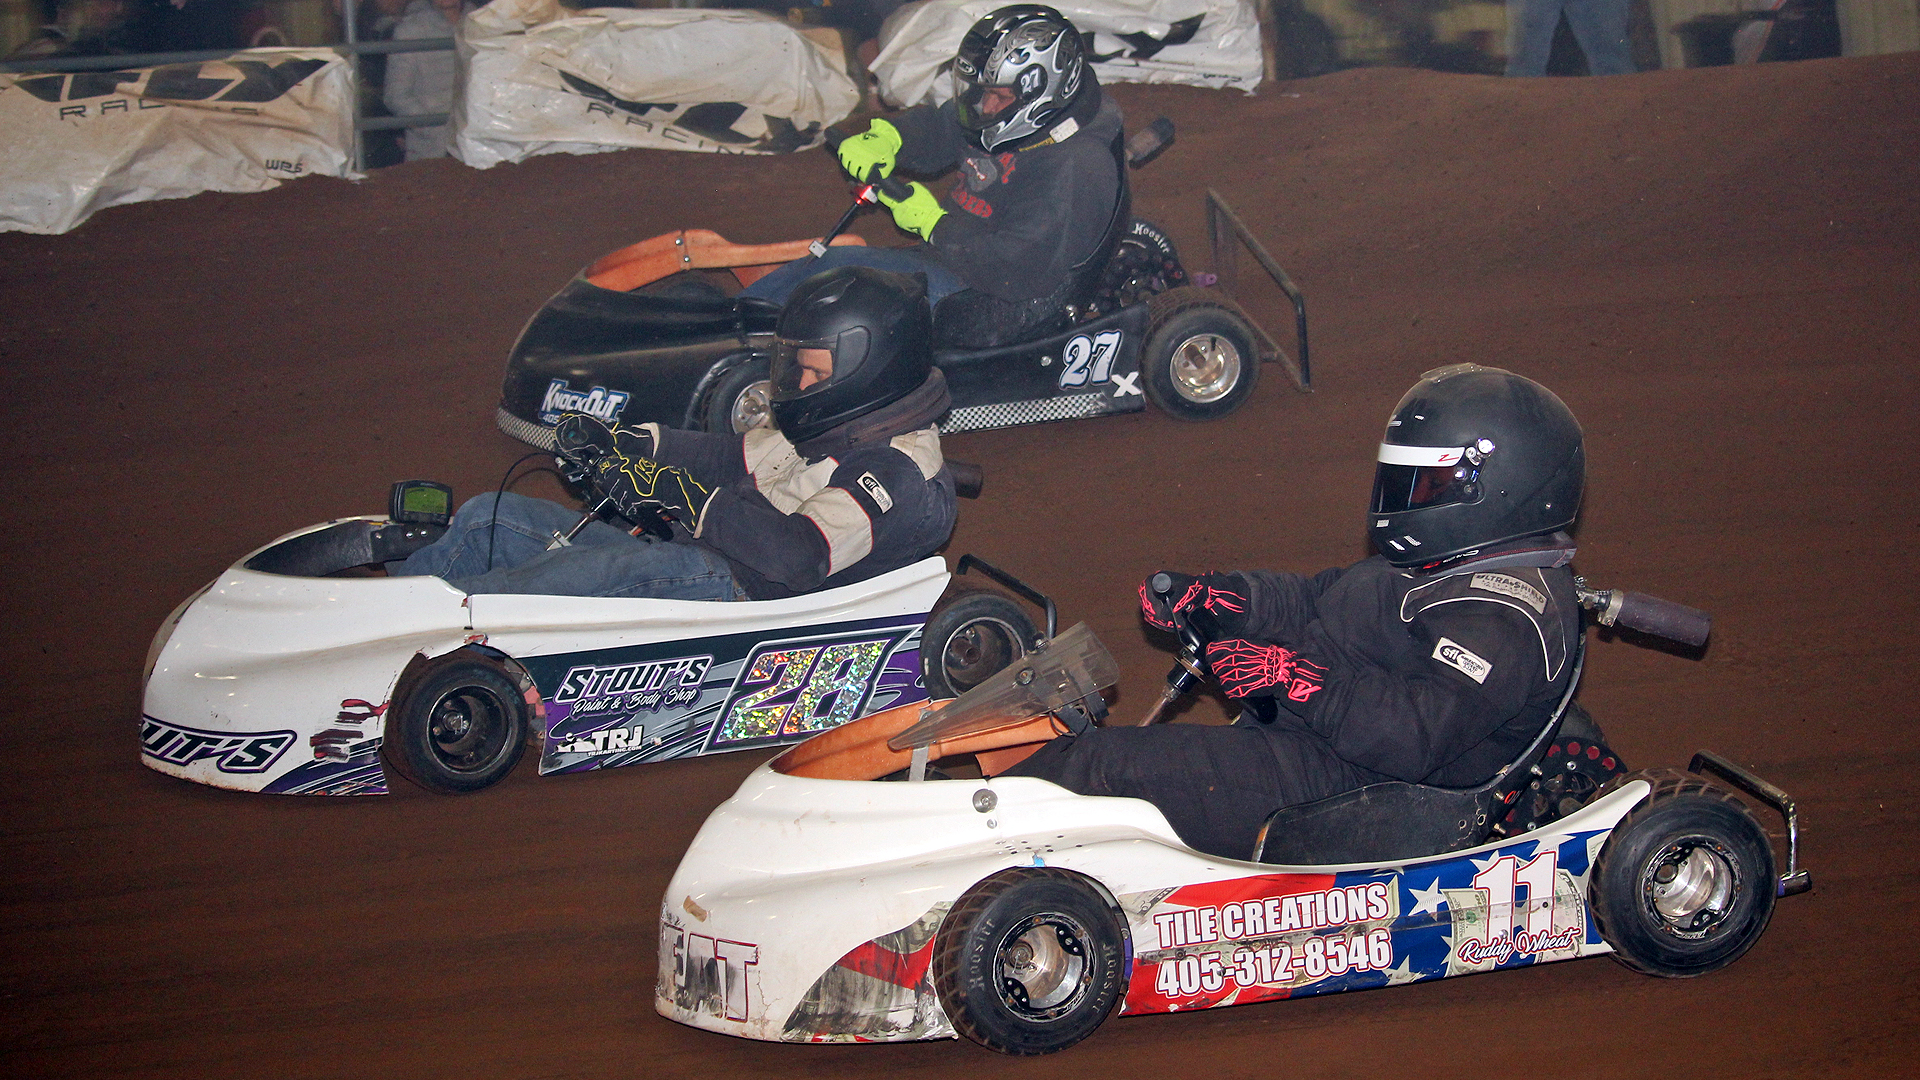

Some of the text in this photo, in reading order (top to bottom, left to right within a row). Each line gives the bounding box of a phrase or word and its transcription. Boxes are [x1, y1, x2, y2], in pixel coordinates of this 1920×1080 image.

[1020, 67, 1040, 95] 27
[1060, 330, 1122, 390] 27
[554, 655, 714, 703] STOUT'S
[572, 688, 698, 716] Paint & Body Shop
[716, 639, 891, 743] 28
[591, 725, 643, 750] TRJ
[1154, 882, 1389, 949] TILE CREATIONS
[1474, 851, 1557, 946] 11
[1155, 927, 1393, 999] 405-312-8546
[1458, 927, 1582, 965] Ruddy Wheat
